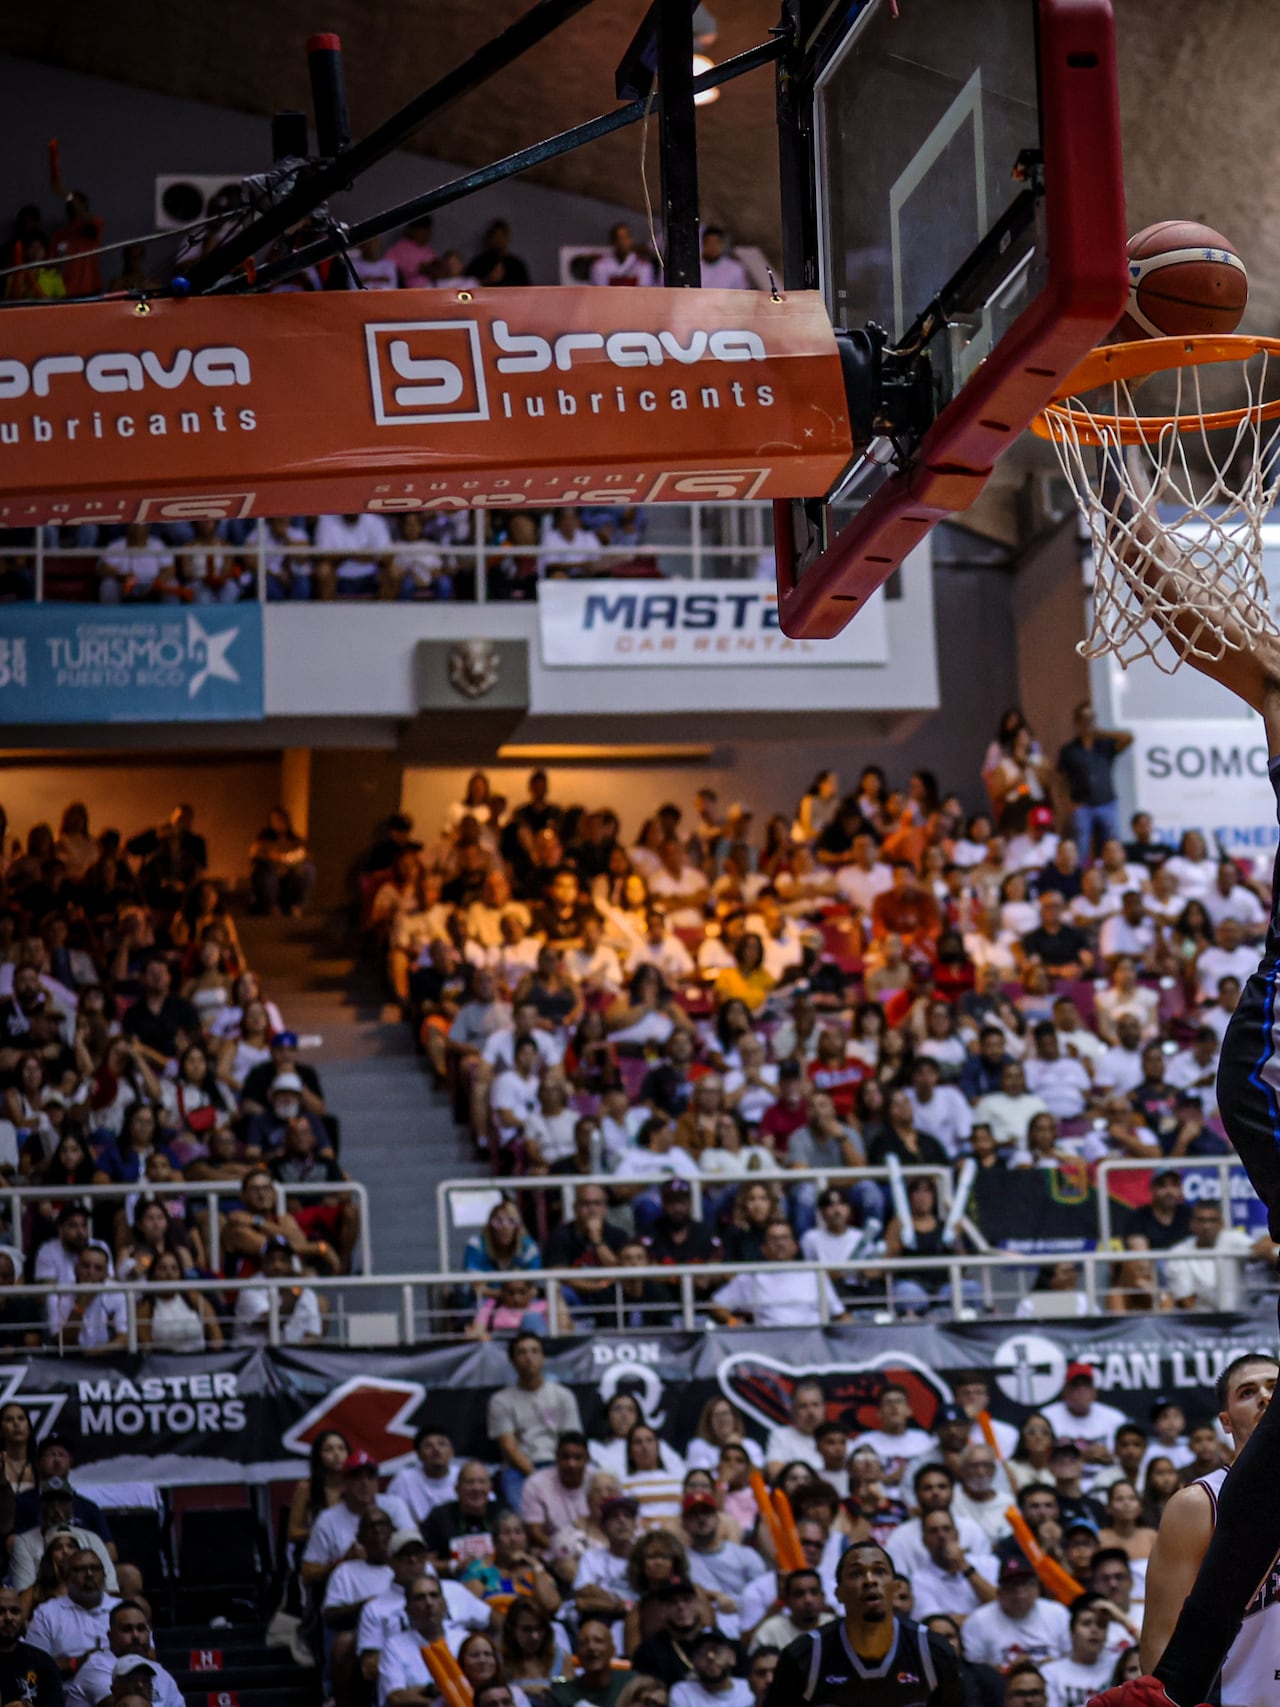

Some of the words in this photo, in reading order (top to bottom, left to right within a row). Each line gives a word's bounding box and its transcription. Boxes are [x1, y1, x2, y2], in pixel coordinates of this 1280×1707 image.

[492, 319, 767, 374] brava
[502, 380, 775, 418] lubricants
[47, 637, 184, 669] TURISMO
[614, 635, 678, 654] CAR
[693, 635, 818, 653] RENTAL
[57, 668, 130, 688] PUERTO
[135, 668, 186, 688] RICO
[592, 1342, 660, 1365] DON
[78, 1372, 238, 1403] MASTER
[1076, 1352, 1162, 1392] SAN
[597, 1362, 667, 1430] Q
[79, 1400, 247, 1437] MOTORS
